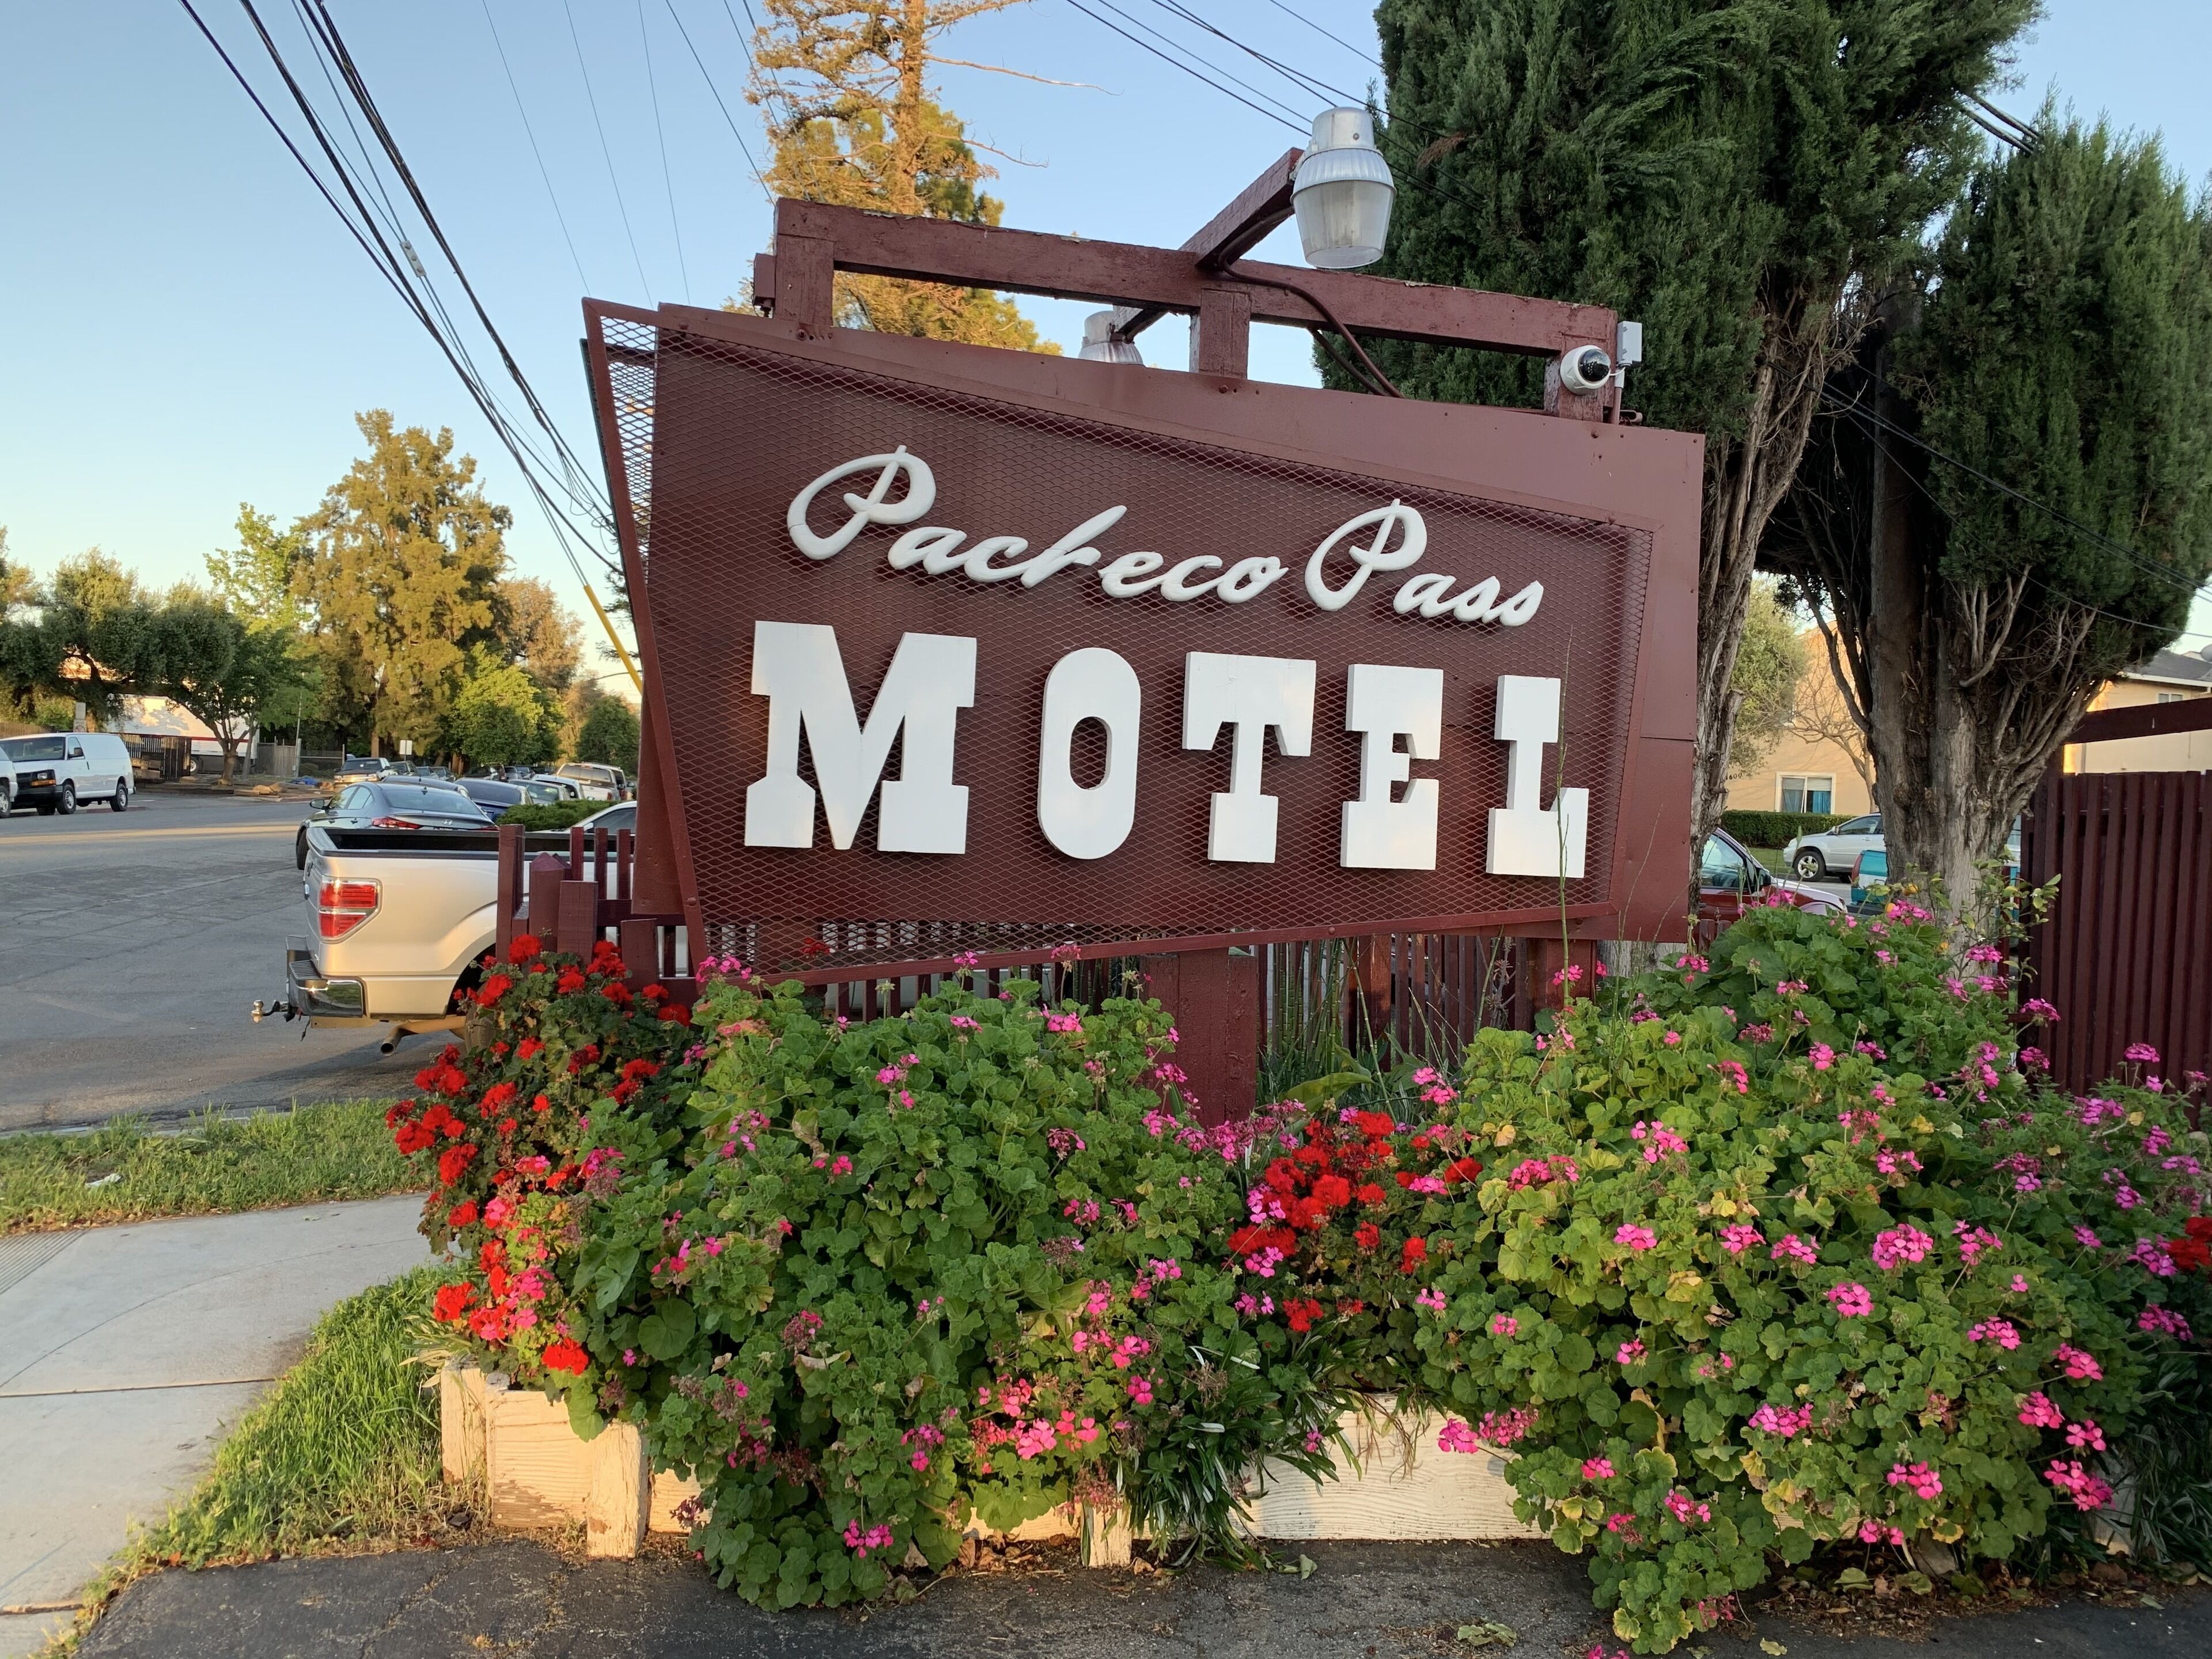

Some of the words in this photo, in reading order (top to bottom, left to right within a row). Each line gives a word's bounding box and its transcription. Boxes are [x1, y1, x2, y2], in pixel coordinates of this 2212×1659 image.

[787, 445, 1289, 604] Pacheco
[1305, 498, 1544, 627] Pass
[744, 620, 1589, 878] MOTEL
